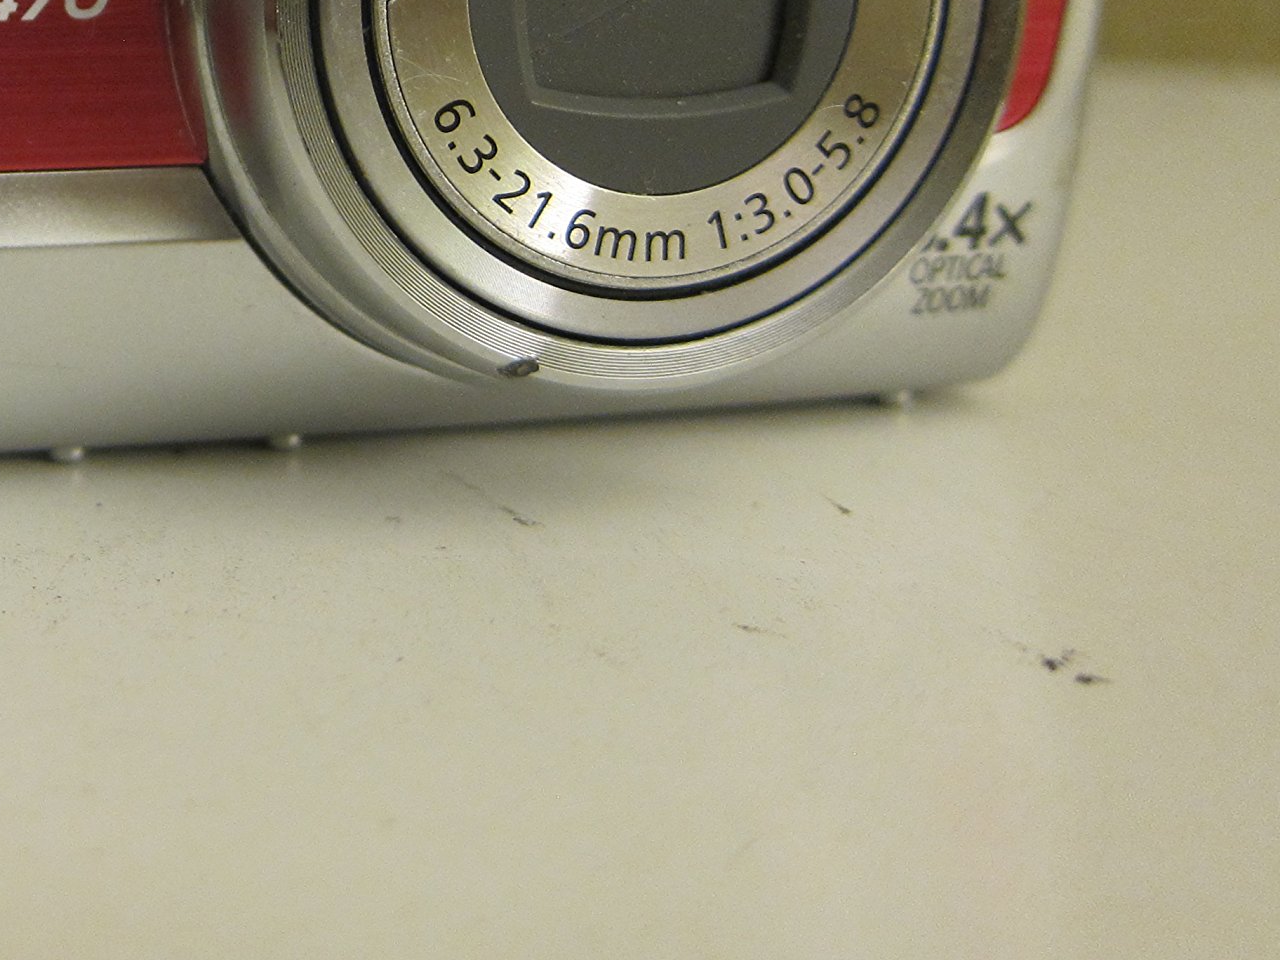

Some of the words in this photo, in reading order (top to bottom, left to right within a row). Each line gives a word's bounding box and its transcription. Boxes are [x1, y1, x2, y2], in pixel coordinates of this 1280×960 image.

[433, 98, 686, 262] 6.3-21.6mm
[706, 93, 880, 250] 1:3.0-5.8
[920, 191, 1034, 252] .4x
[909, 252, 1007, 286] OPTICAL
[912, 283, 992, 316] ZOOM
